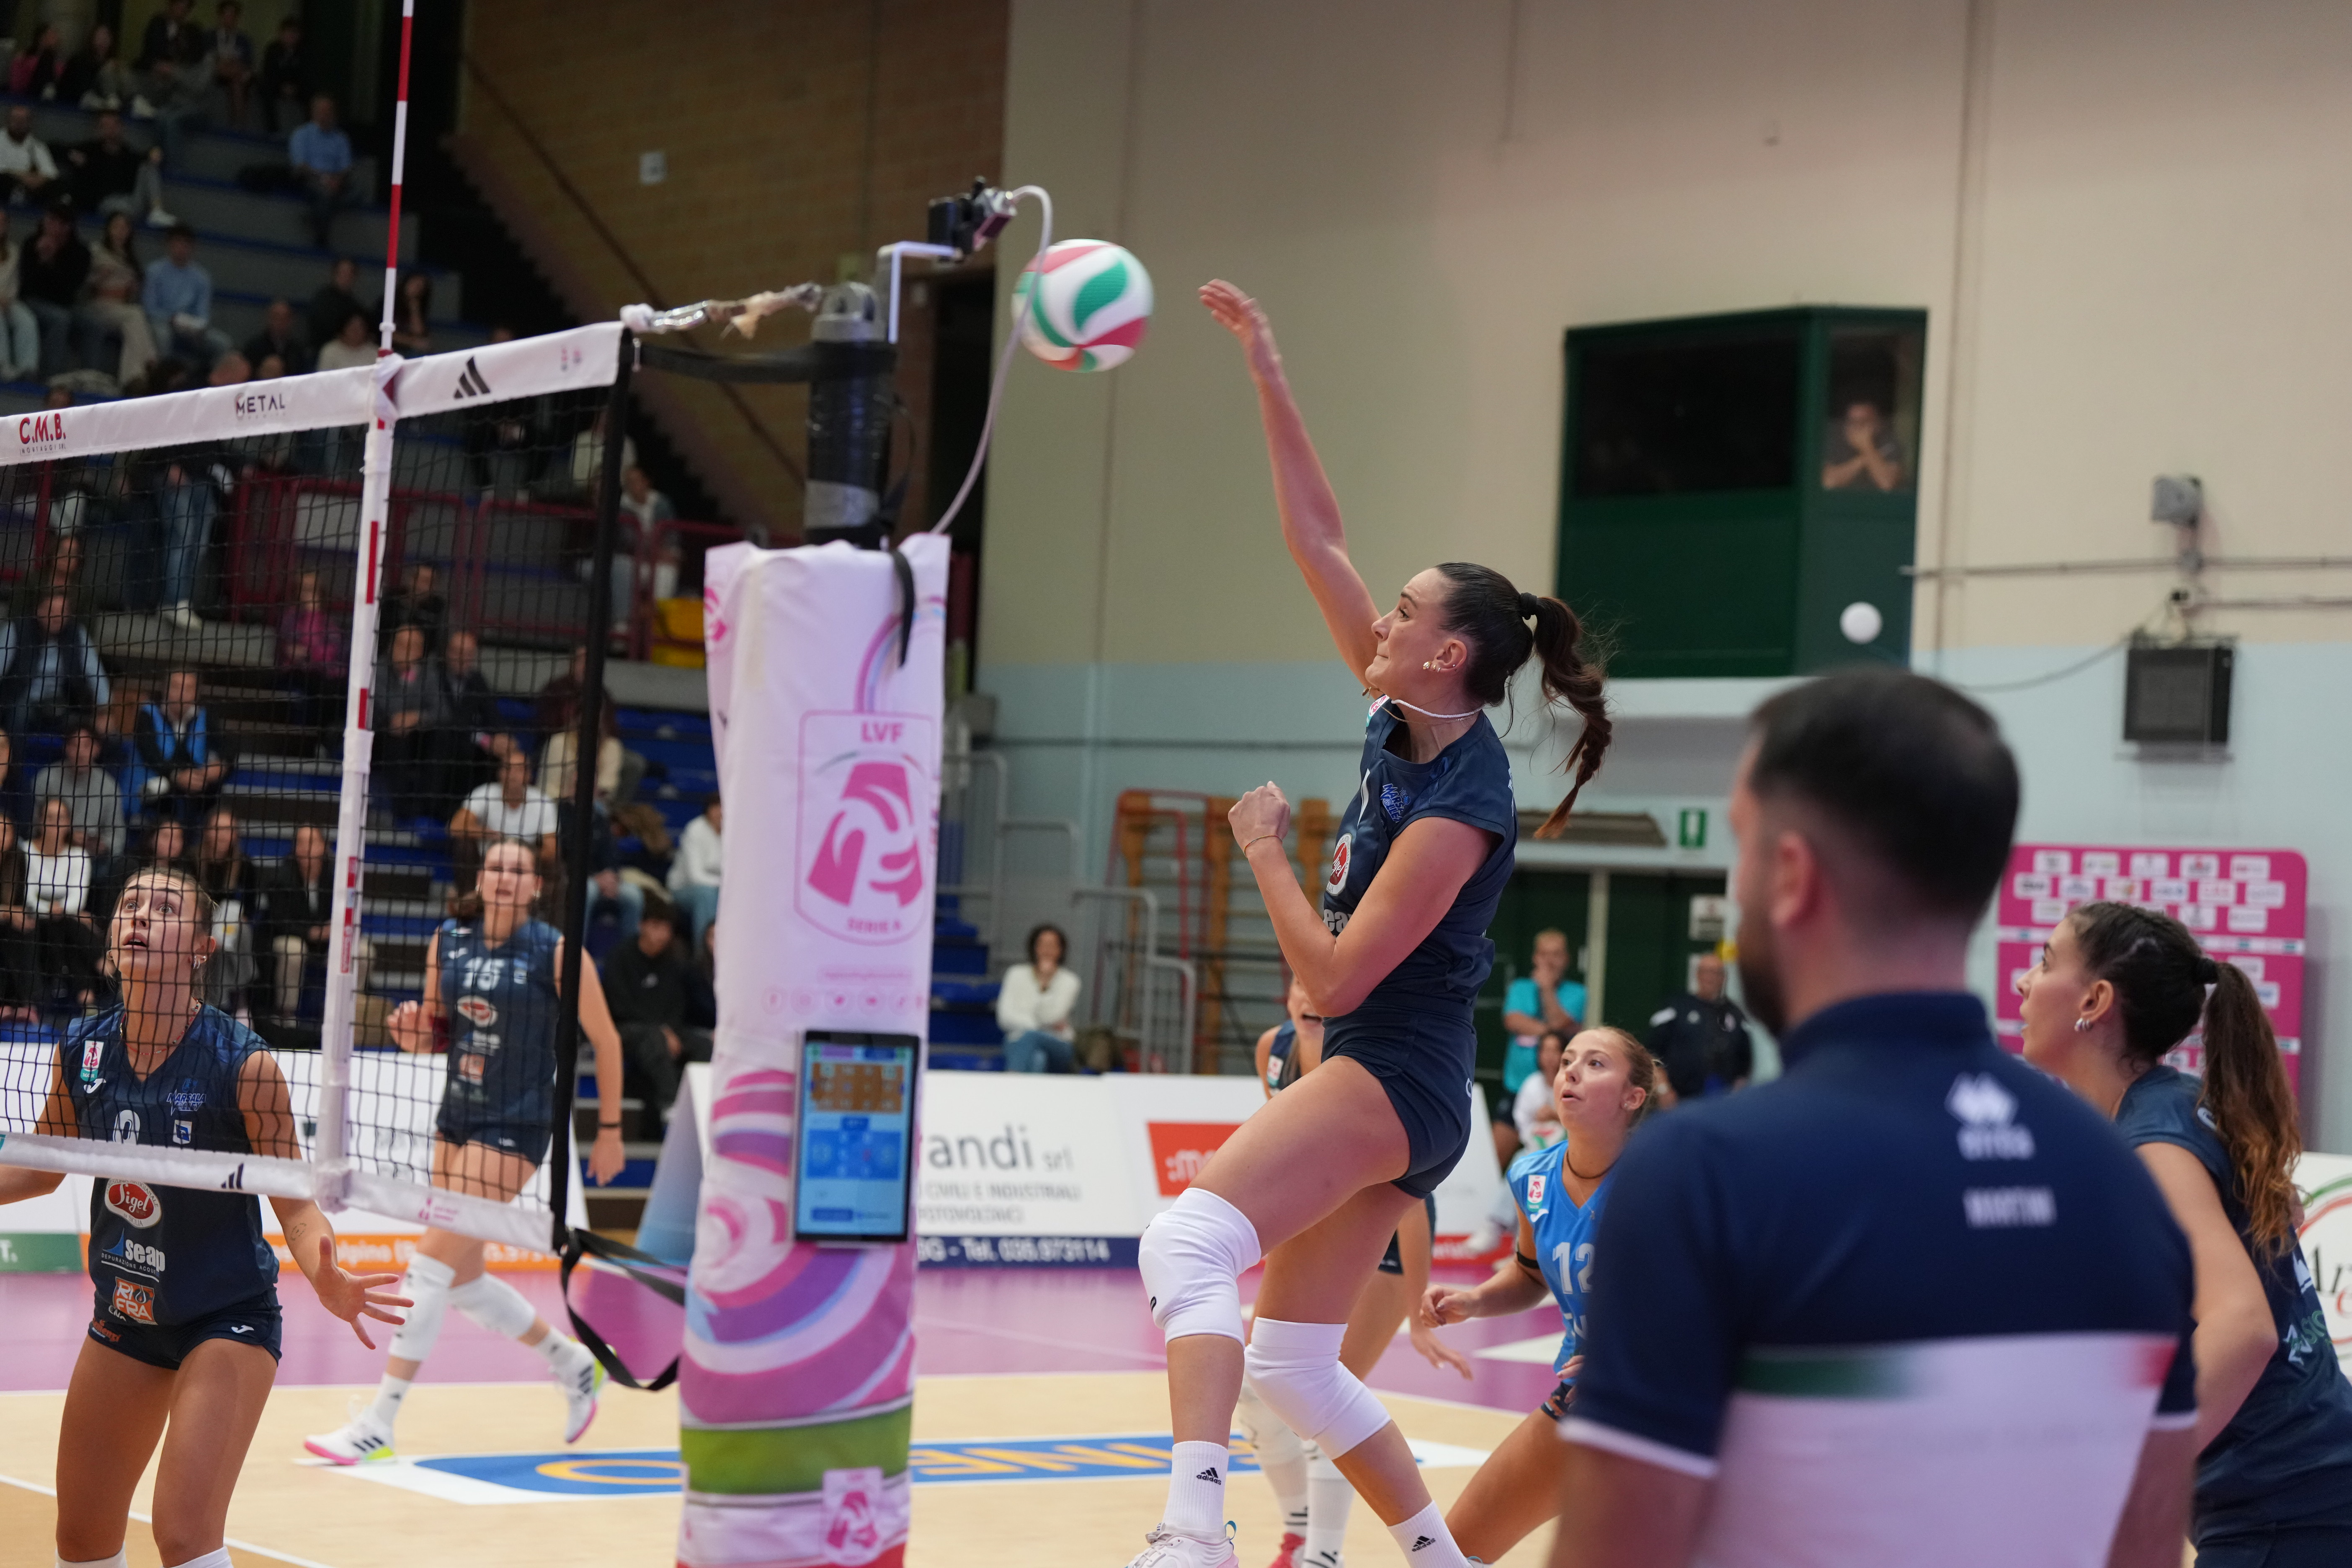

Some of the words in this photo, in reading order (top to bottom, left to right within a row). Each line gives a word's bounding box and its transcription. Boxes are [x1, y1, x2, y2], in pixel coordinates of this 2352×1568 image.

[236, 393, 286, 414] METAL
[19, 413, 66, 444] C.M.B.
[861, 721, 903, 743] LVF
[113, 1183, 152, 1213] Sigel
[101, 1252, 137, 1269] DEPURAZIONE
[139, 1265, 156, 1275] ACQUE
[125, 1239, 165, 1272] seap
[1553, 1241, 1595, 1295] 12
[116, 1298, 152, 1321] FRA
[1196, 1474, 1222, 1485] adidas
[1411, 1537, 1436, 1552] adidas
